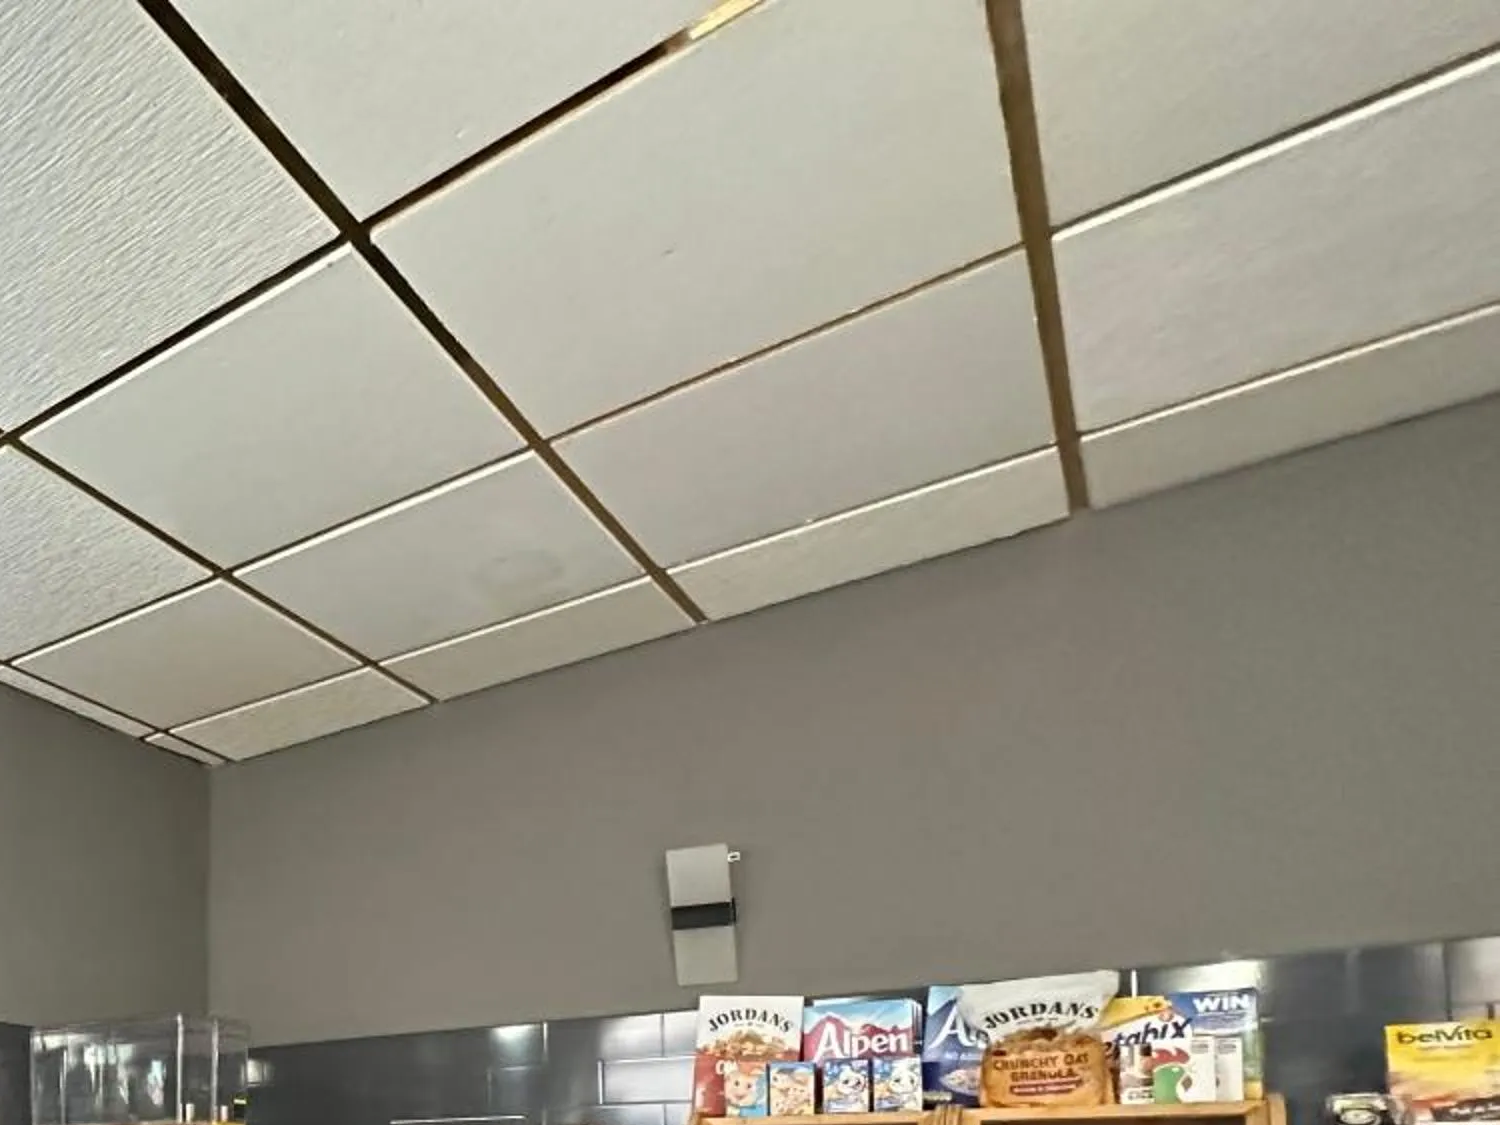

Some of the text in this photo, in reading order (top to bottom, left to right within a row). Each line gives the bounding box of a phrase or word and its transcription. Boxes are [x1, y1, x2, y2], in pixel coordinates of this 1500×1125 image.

[984, 1001, 1098, 1029] JORDANS
[1192, 993, 1250, 1013] WIN
[707, 1008, 792, 1034] JORDANS
[810, 1021, 909, 1067] Alpen
[1398, 1026, 1493, 1044] belVita
